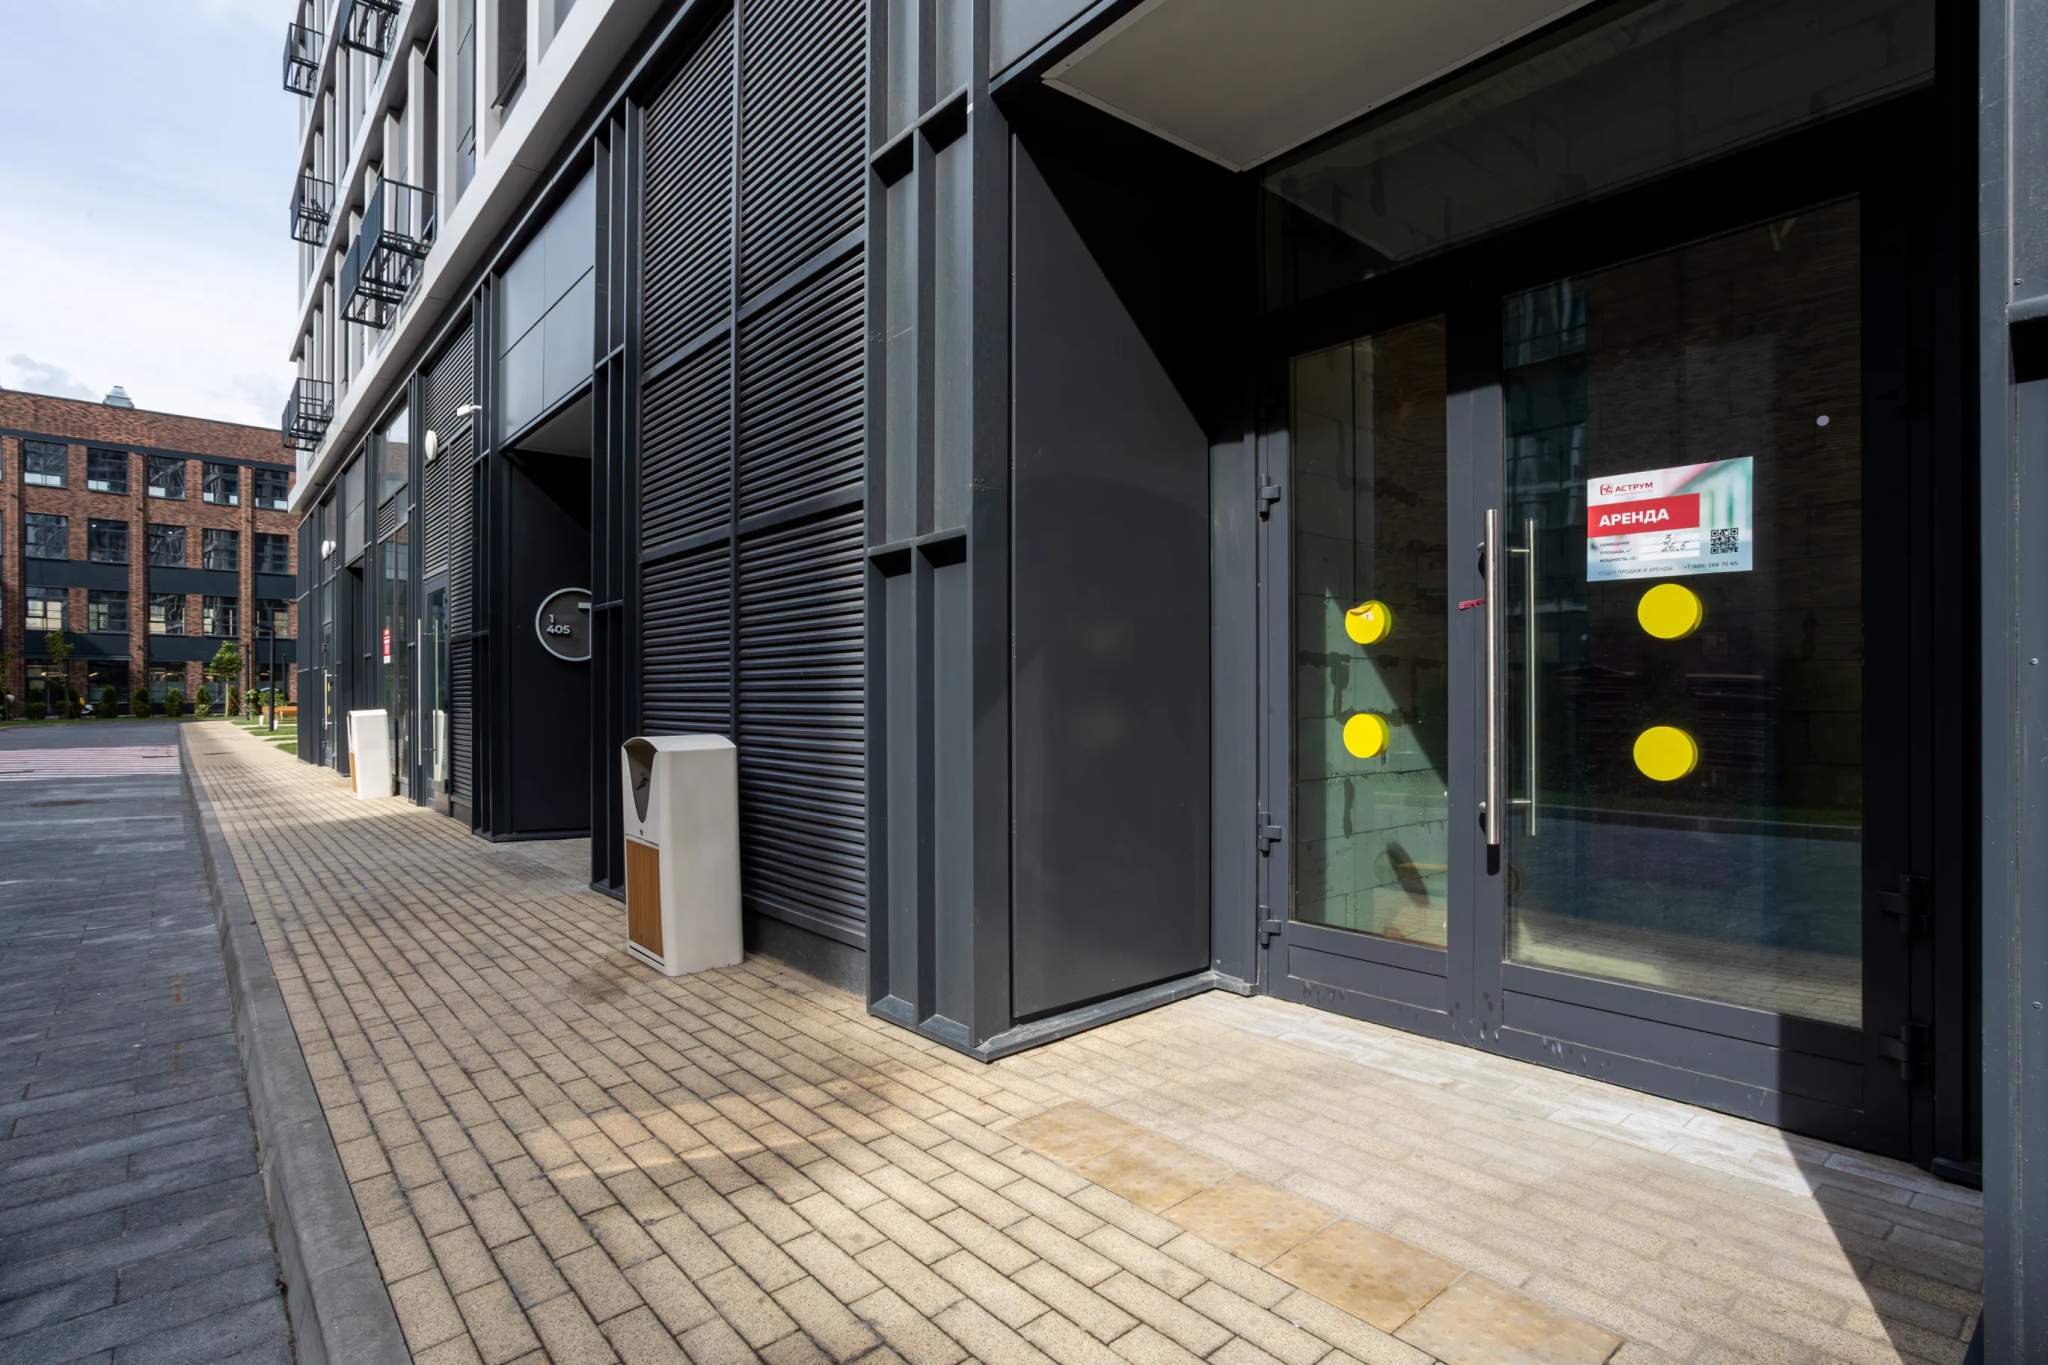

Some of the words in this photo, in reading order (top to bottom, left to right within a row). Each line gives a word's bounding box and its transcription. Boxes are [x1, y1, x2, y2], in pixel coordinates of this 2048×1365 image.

[1615, 481, 1653, 493] АСТРУМ
[1599, 508, 1670, 527] АРЕНДА
[549, 614, 555, 623] 1
[546, 625, 571, 634] 405
